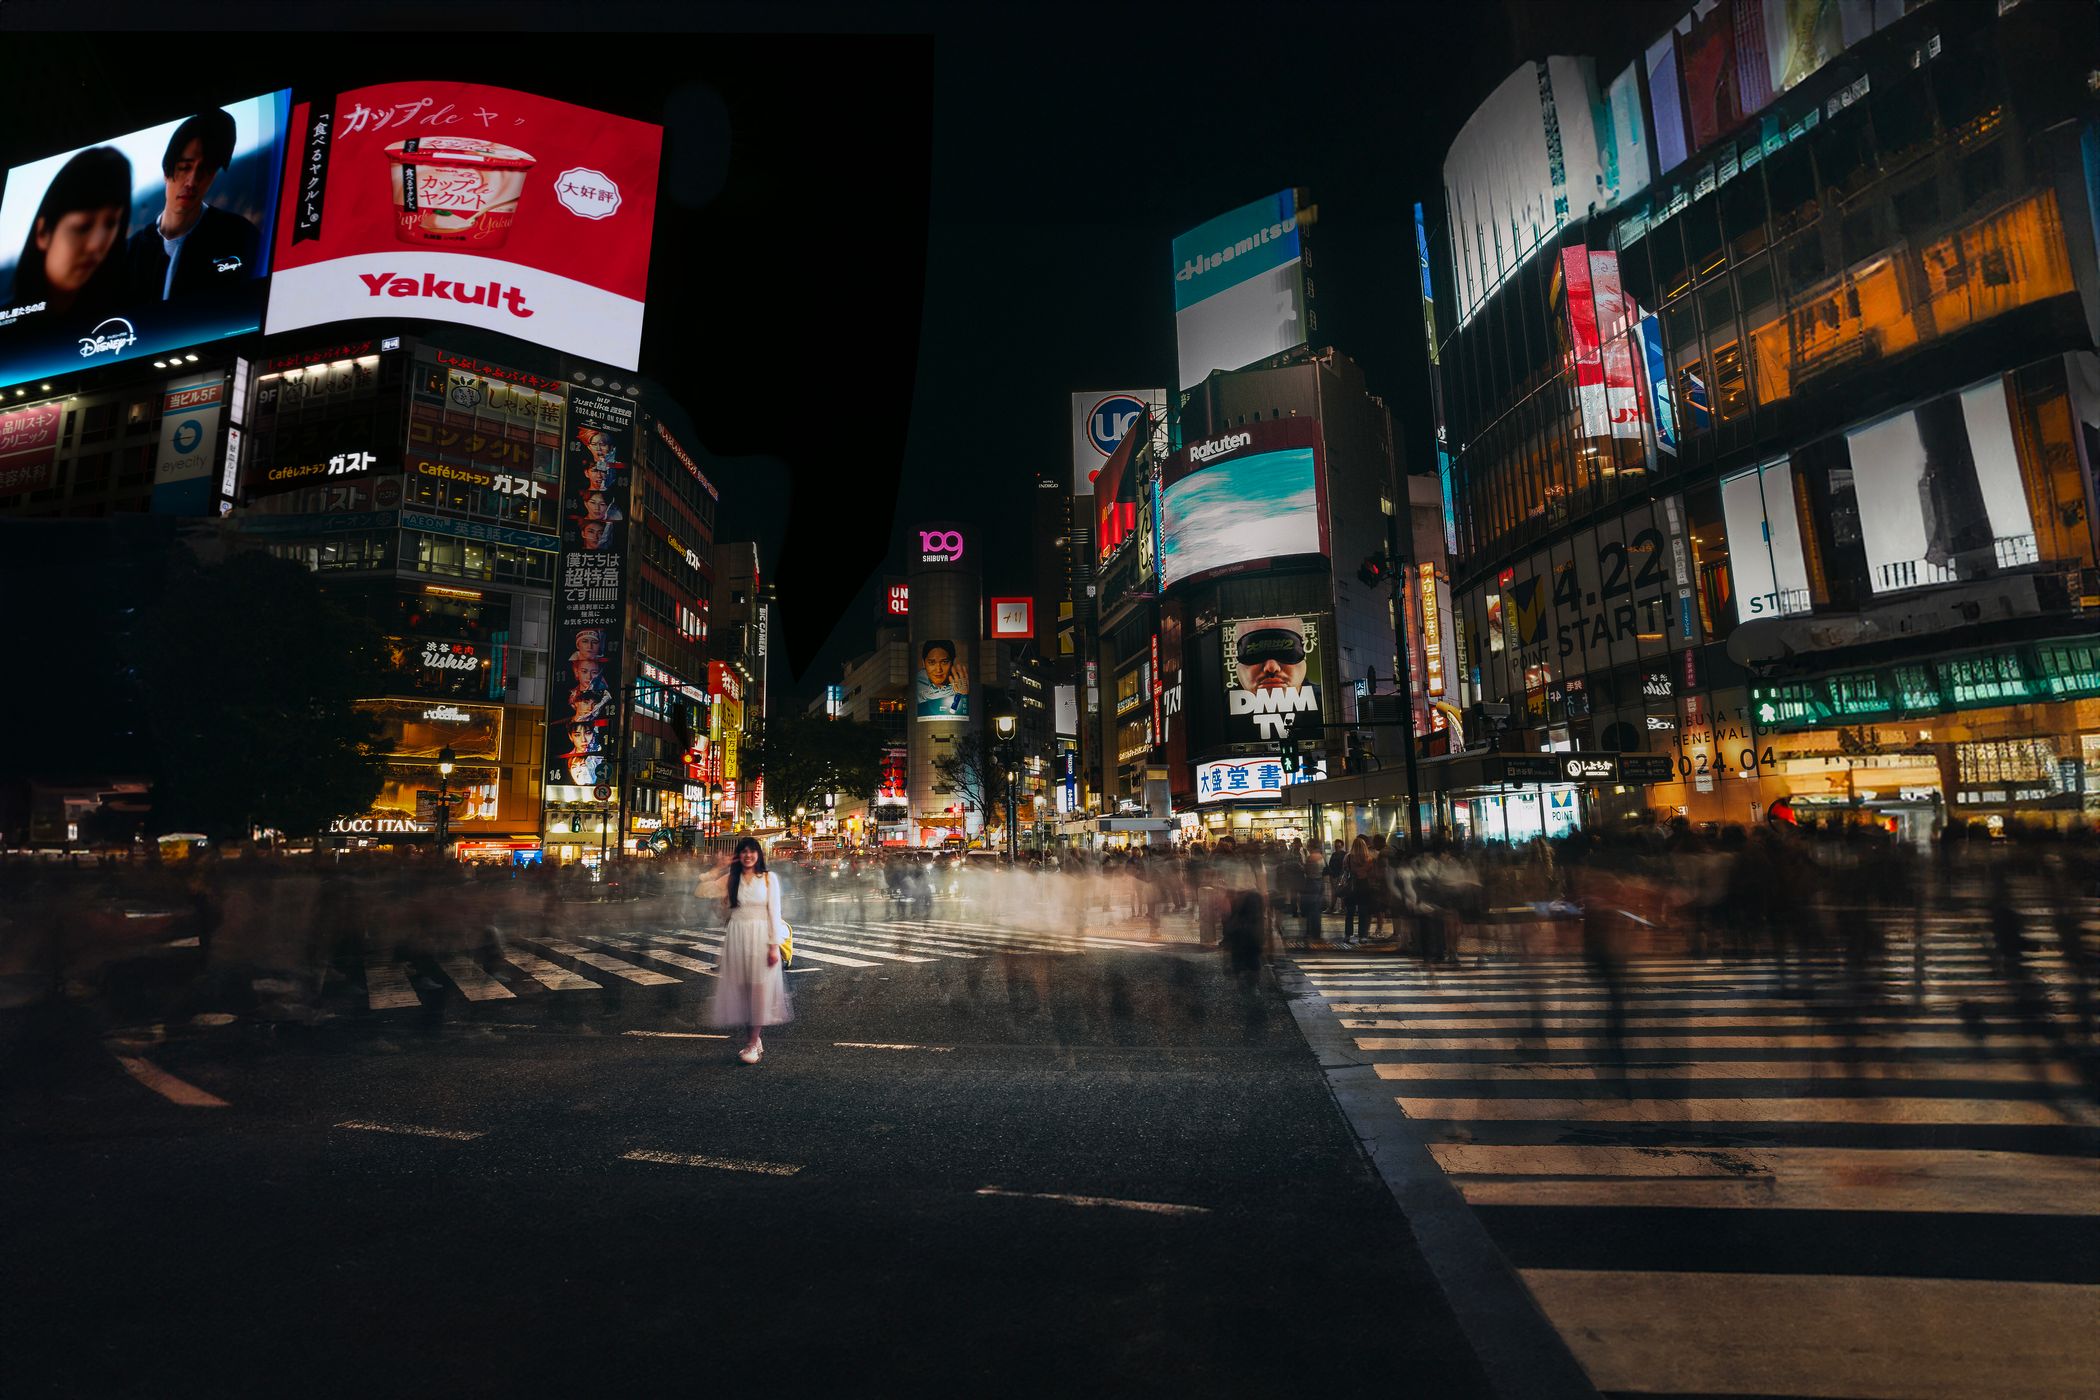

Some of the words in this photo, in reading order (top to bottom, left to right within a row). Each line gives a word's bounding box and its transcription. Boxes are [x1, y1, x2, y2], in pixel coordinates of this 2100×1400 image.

[562, 181, 615, 204] 大好評
[1176, 216, 1298, 281] Hisamitsu
[358, 272, 535, 319] Yakult
[437, 351, 561, 392] しゃぶしゃぶバイキング
[169, 387, 217, 408] 当ビル5F
[259, 389, 277, 404] 9F
[489, 388, 559, 421] しゃぶ葉
[1190, 432, 1251, 462] Rakuten
[162, 454, 208, 473] eyecity
[327, 451, 377, 475] ガスト
[492, 474, 547, 499] ガスト
[408, 514, 445, 529] AEON
[454, 521, 557, 548] 英会話イーオン
[566, 552, 620, 568] 僕たちは
[919, 530, 964, 562] 109
[922, 554, 949, 563] SHIBUYA
[564, 567, 619, 587] 超特急
[1553, 527, 1670, 612] 4.22
[1302, 622, 1319, 654] 再び
[1556, 592, 1675, 657] START!
[426, 641, 451, 653] 渋谷
[758, 622, 766, 657] CAMERA
[420, 650, 479, 671] Ushi8
[1222, 626, 1239, 688] 脱出せよ
[1229, 685, 1319, 715] DMM
[1252, 712, 1296, 740] TV
[1672, 727, 1749, 747] RENEWAL
[1551, 810, 1574, 822] POINT
